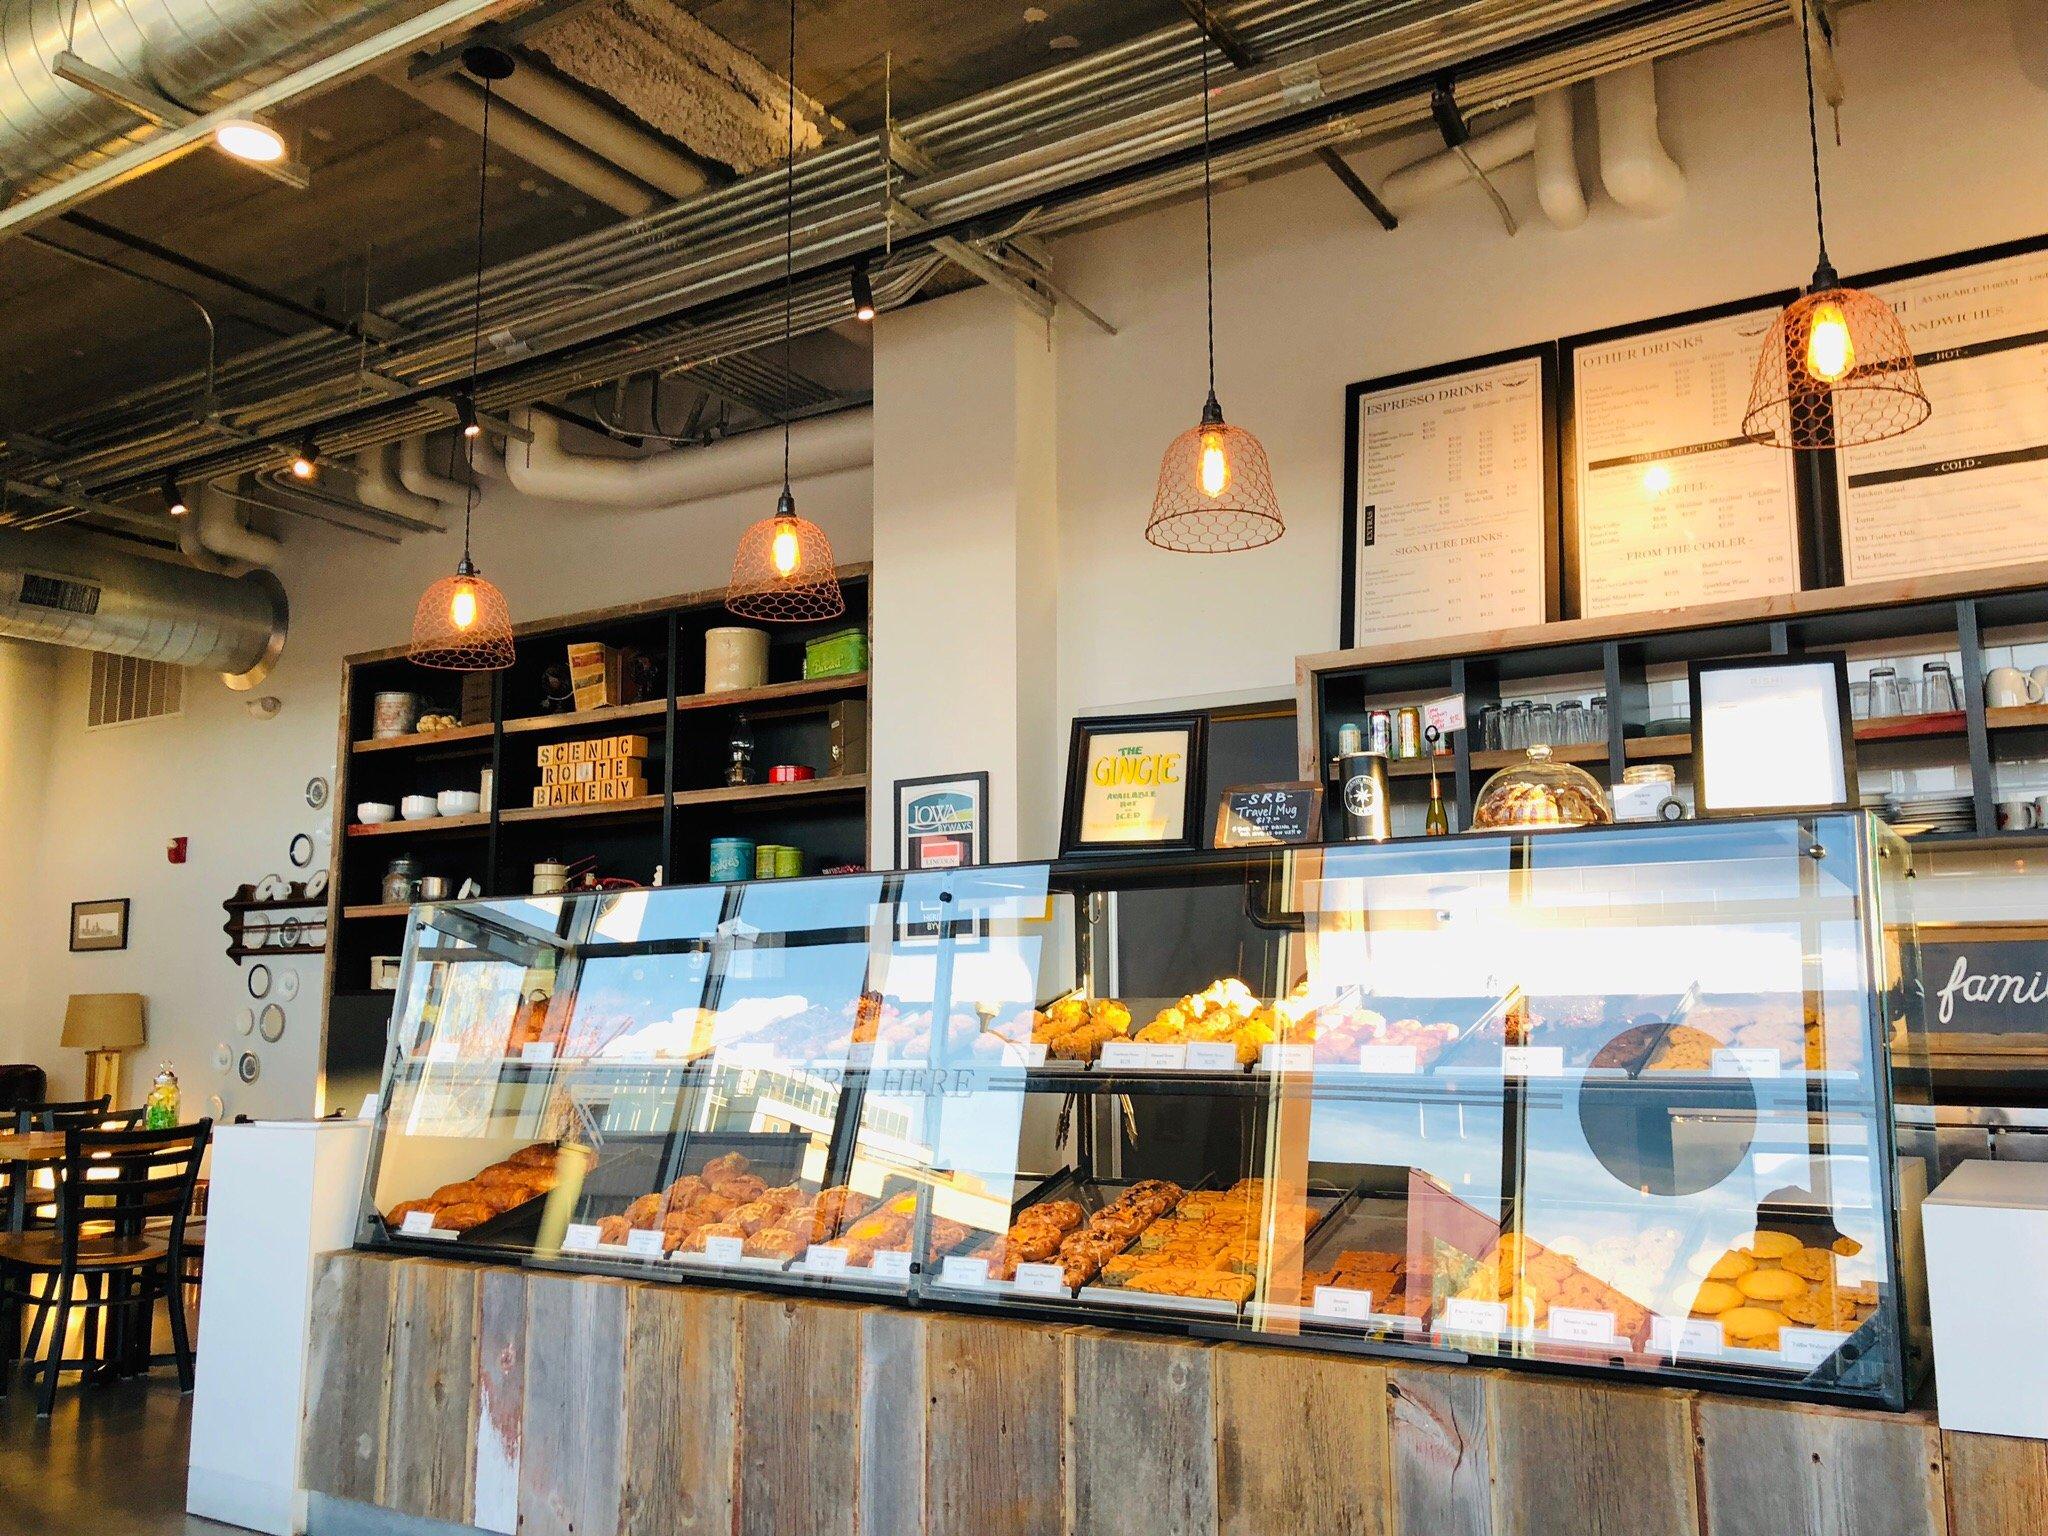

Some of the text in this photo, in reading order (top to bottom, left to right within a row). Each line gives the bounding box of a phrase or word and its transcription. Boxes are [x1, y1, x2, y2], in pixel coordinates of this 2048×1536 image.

[1583, 348, 1637, 369] OTHER
[1642, 336, 1703, 360] DRINKS
[1936, 350, 1961, 361] HOT
[1366, 393, 1435, 416] ESPRESSO
[1438, 381, 1493, 403] DRINKS
[1940, 458, 1976, 472] COLD
[1395, 531, 1503, 555] SIGNATURE DRINKS
[1626, 536, 1747, 561] FROM THE COOLER
[540, 738, 629, 764] SCENIC
[1117, 746, 1144, 757] THE
[545, 760, 623, 783] ROUTE
[537, 780, 629, 805] BAKERY
[1106, 791, 1157, 800] AVAILABLE
[914, 804, 958, 824] IOWA
[1115, 812, 1141, 821] ICED
[1235, 802, 1298, 819] Travel Mug
[938, 821, 972, 833] BYWAYS
[1936, 955, 2048, 1024] fami
[879, 1068, 975, 1098] HERE
